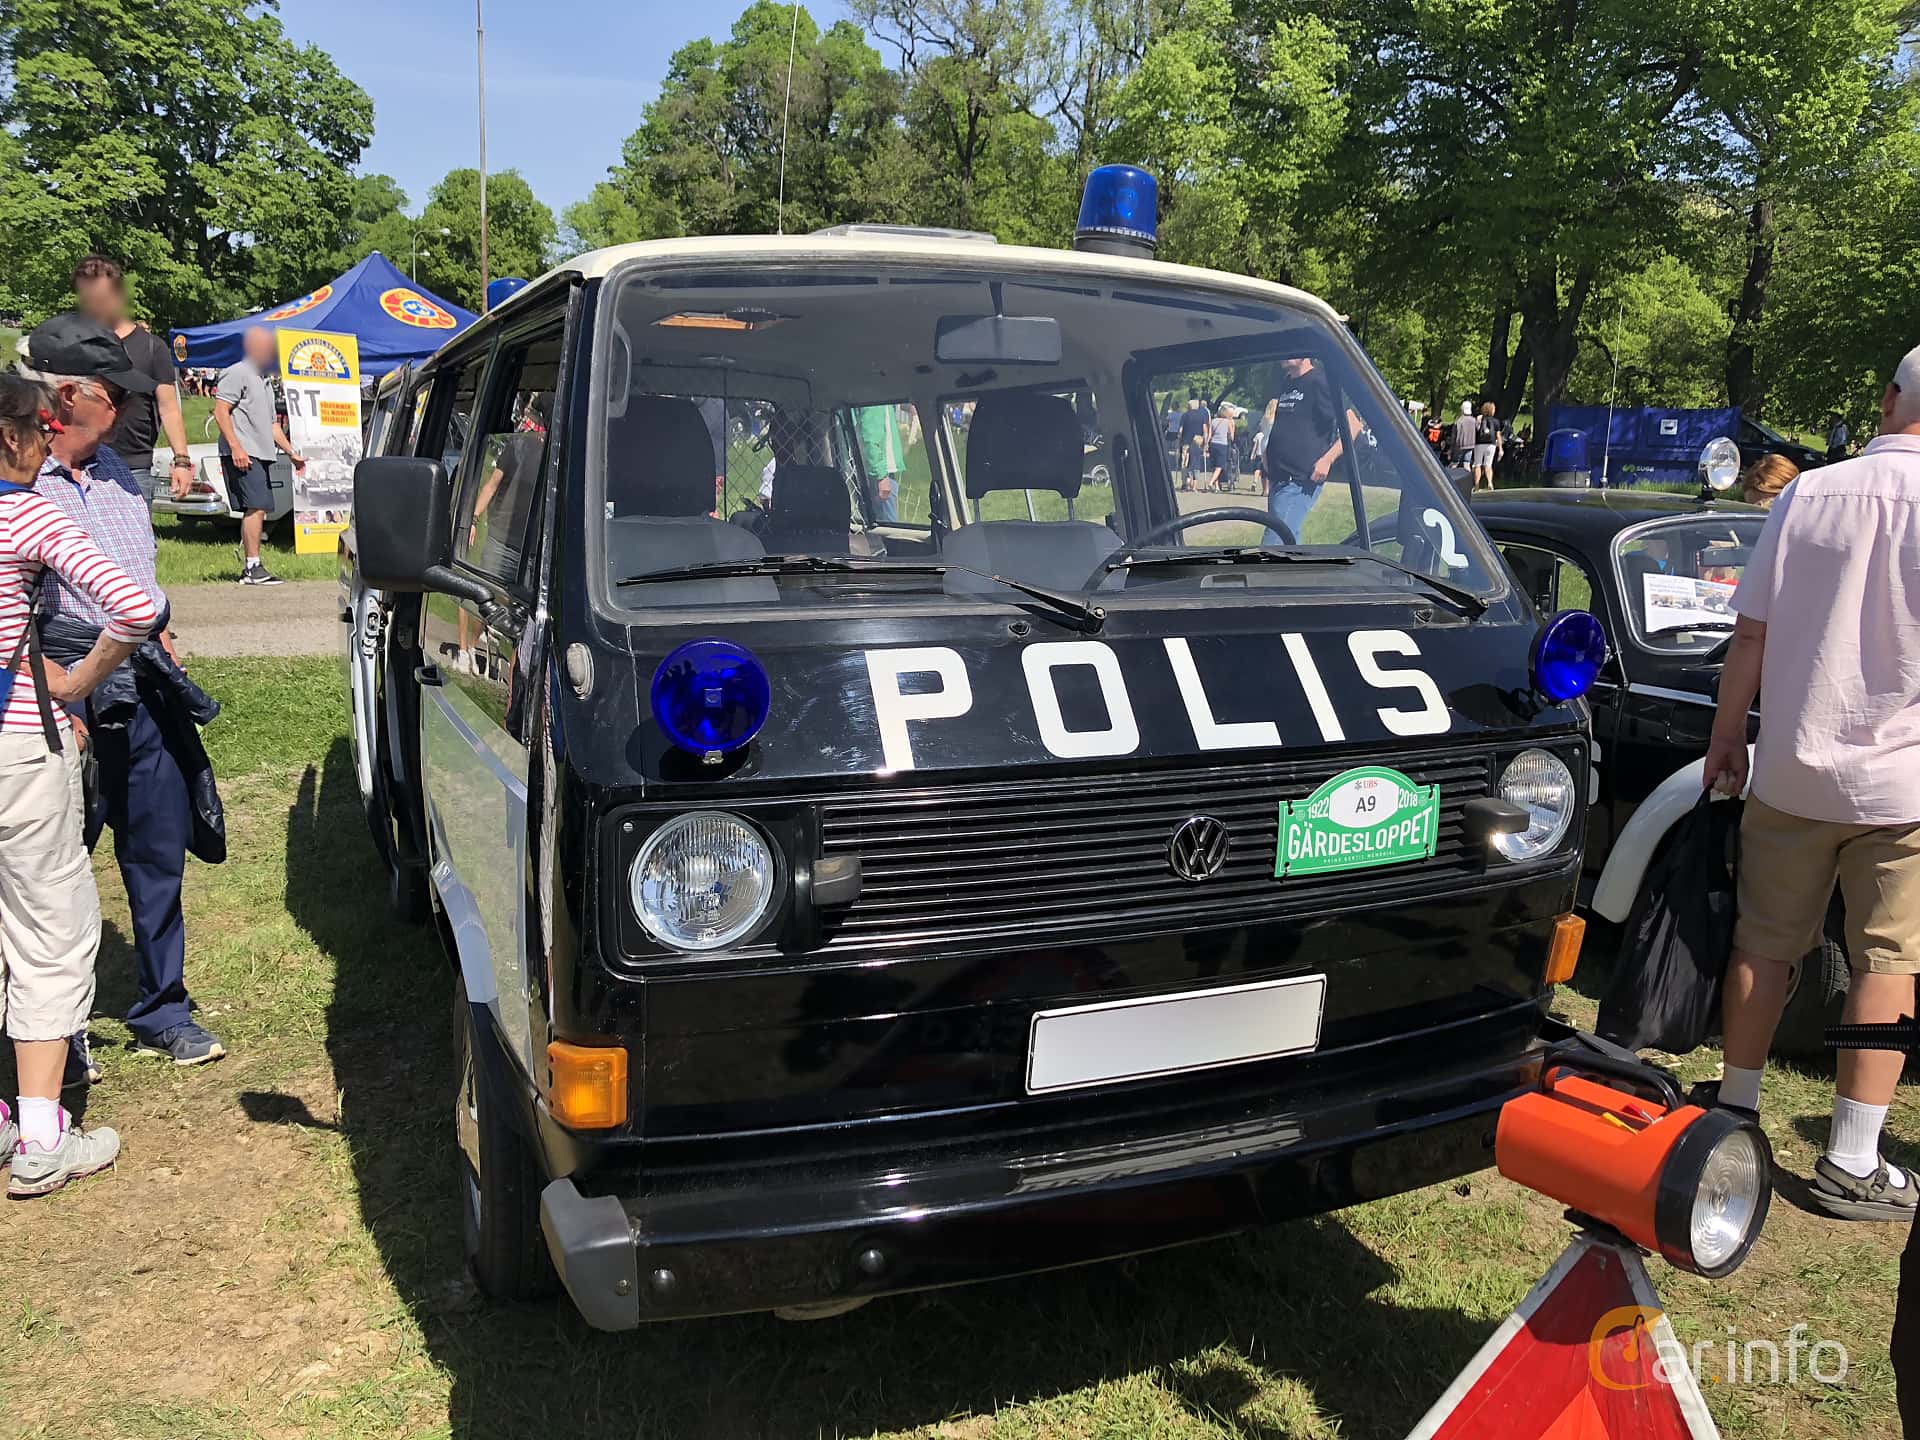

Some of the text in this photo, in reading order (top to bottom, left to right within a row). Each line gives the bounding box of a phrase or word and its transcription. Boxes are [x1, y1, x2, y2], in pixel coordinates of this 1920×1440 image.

[1423, 508, 1469, 568] 2
[864, 629, 1452, 772] POLIS
[1363, 780, 1379, 789] UBS
[1308, 797, 1330, 819] 1922
[1355, 795, 1377, 813] A9
[1398, 789, 1418, 809] 2018
[1287, 806, 1433, 860] GÄRDESLOPPET
